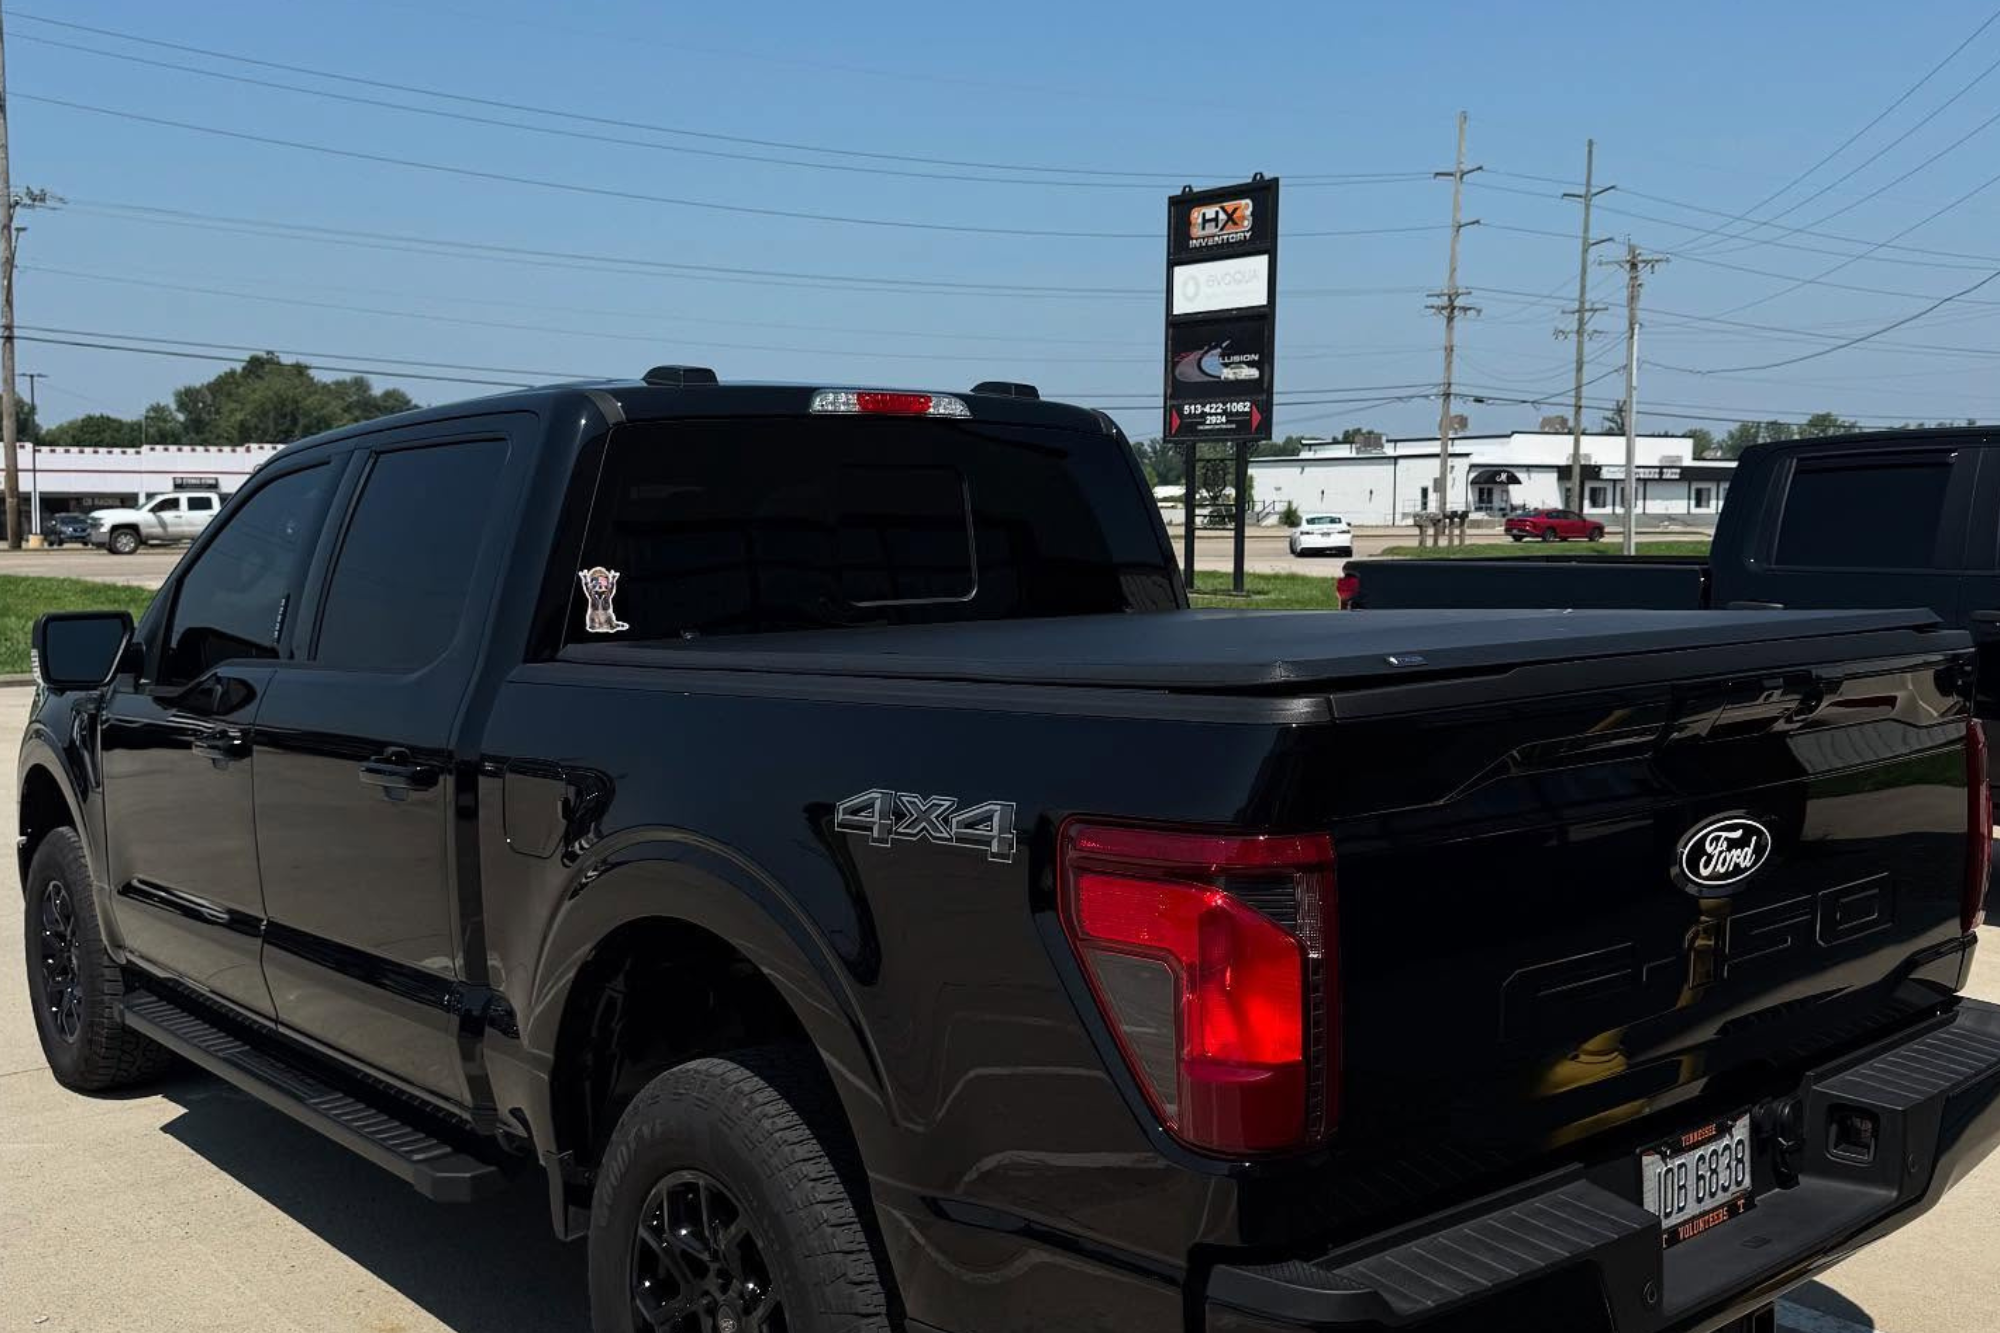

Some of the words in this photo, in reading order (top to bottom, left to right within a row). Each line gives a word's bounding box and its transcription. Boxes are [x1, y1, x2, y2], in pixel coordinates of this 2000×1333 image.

[1189, 231, 1252, 248] INVENTORY
[1183, 402, 1251, 415] 513-422-1062
[1699, 828, 1757, 877] Ford
[1694, 1137, 1746, 1204] 6838
